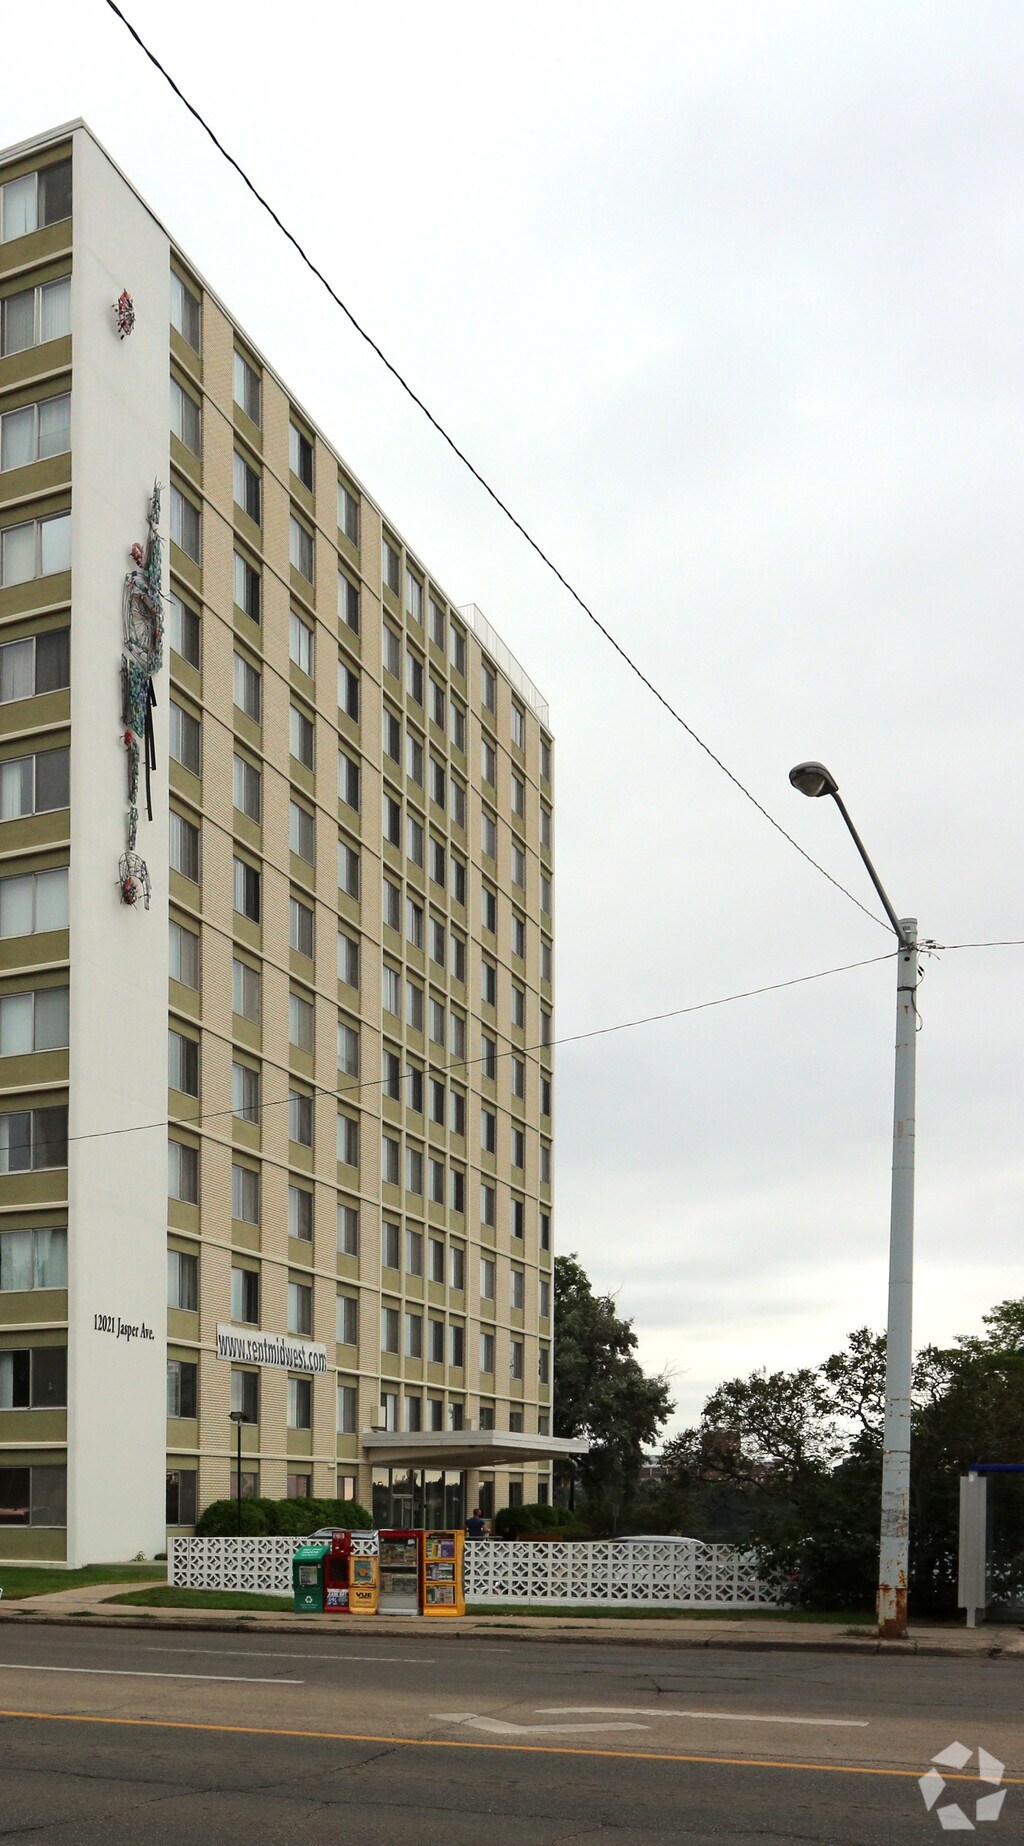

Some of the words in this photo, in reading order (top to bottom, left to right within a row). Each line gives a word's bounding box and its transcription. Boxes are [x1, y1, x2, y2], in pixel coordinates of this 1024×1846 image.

[94, 1314, 115, 1333] 12021
[116, 1317, 139, 1342] Jasper
[140, 1322, 155, 1340] Ave.
[218, 1334, 327, 1372] www.rentmidwest.com
